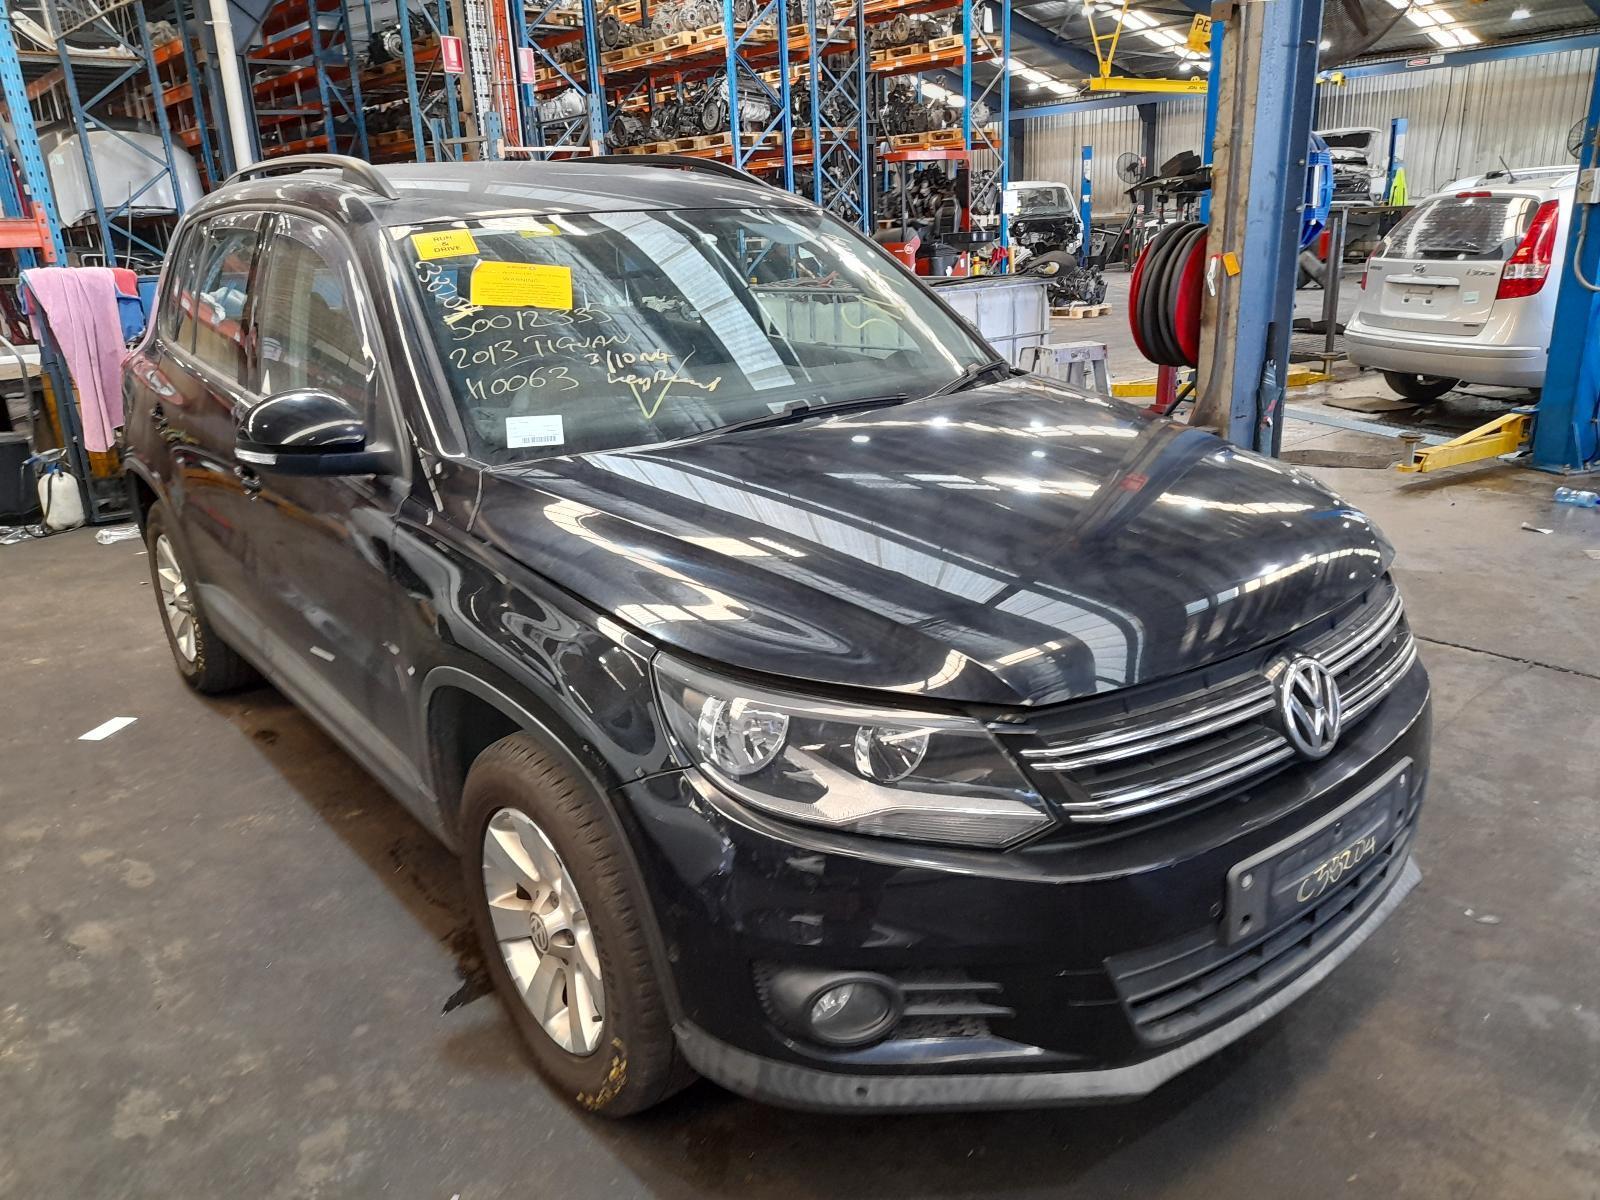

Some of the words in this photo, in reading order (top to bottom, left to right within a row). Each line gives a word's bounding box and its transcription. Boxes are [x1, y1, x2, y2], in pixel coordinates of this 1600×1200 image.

[433, 245, 461, 253] DRIVE
[450, 339, 519, 369] 2013
[522, 333, 631, 357] TIGUAN
